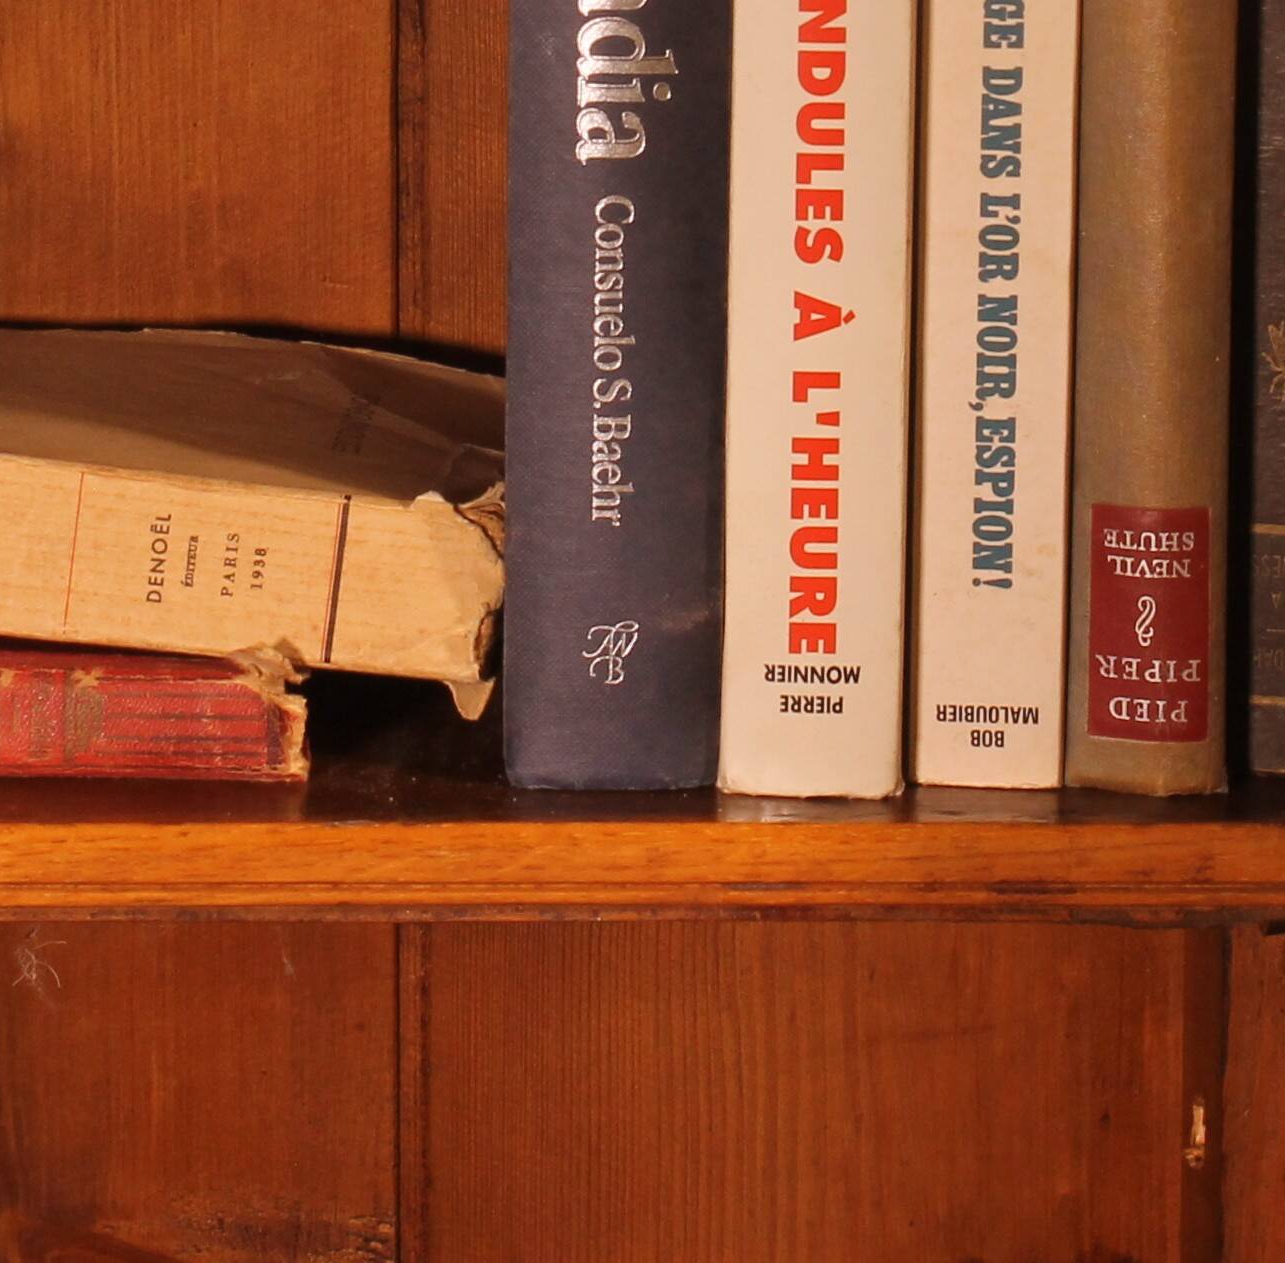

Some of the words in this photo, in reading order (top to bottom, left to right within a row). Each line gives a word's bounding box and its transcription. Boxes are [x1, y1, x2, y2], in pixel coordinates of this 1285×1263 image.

[980, 66, 1023, 178] DANS
[977, 192, 1021, 283] L'OR
[593, 194, 637, 372] Consuelo
[793, 290, 856, 342] À
[968, 294, 1018, 412] NOIR,
[591, 412, 635, 526] Baehr
[788, 371, 841, 655] L'HEURE
[972, 415, 1017, 590] ESPION!
[146, 512, 172, 604] DENOËL
[180, 534, 200, 587] ÉDITEUR
[221, 531, 240, 598] PARIS
[1103, 528, 1195, 552] SHUTE
[250, 546, 268, 590] 1938
[1107, 555, 1191, 578] NEVIL
[764, 663, 861, 684] MONNIER
[1095, 654, 1201, 683] PIPER
[779, 694, 843, 714] PIERRE
[936, 704, 1039, 724] MALOUBIER
[1108, 696, 1189, 723] PIED
[970, 729, 1005, 748] BOB
